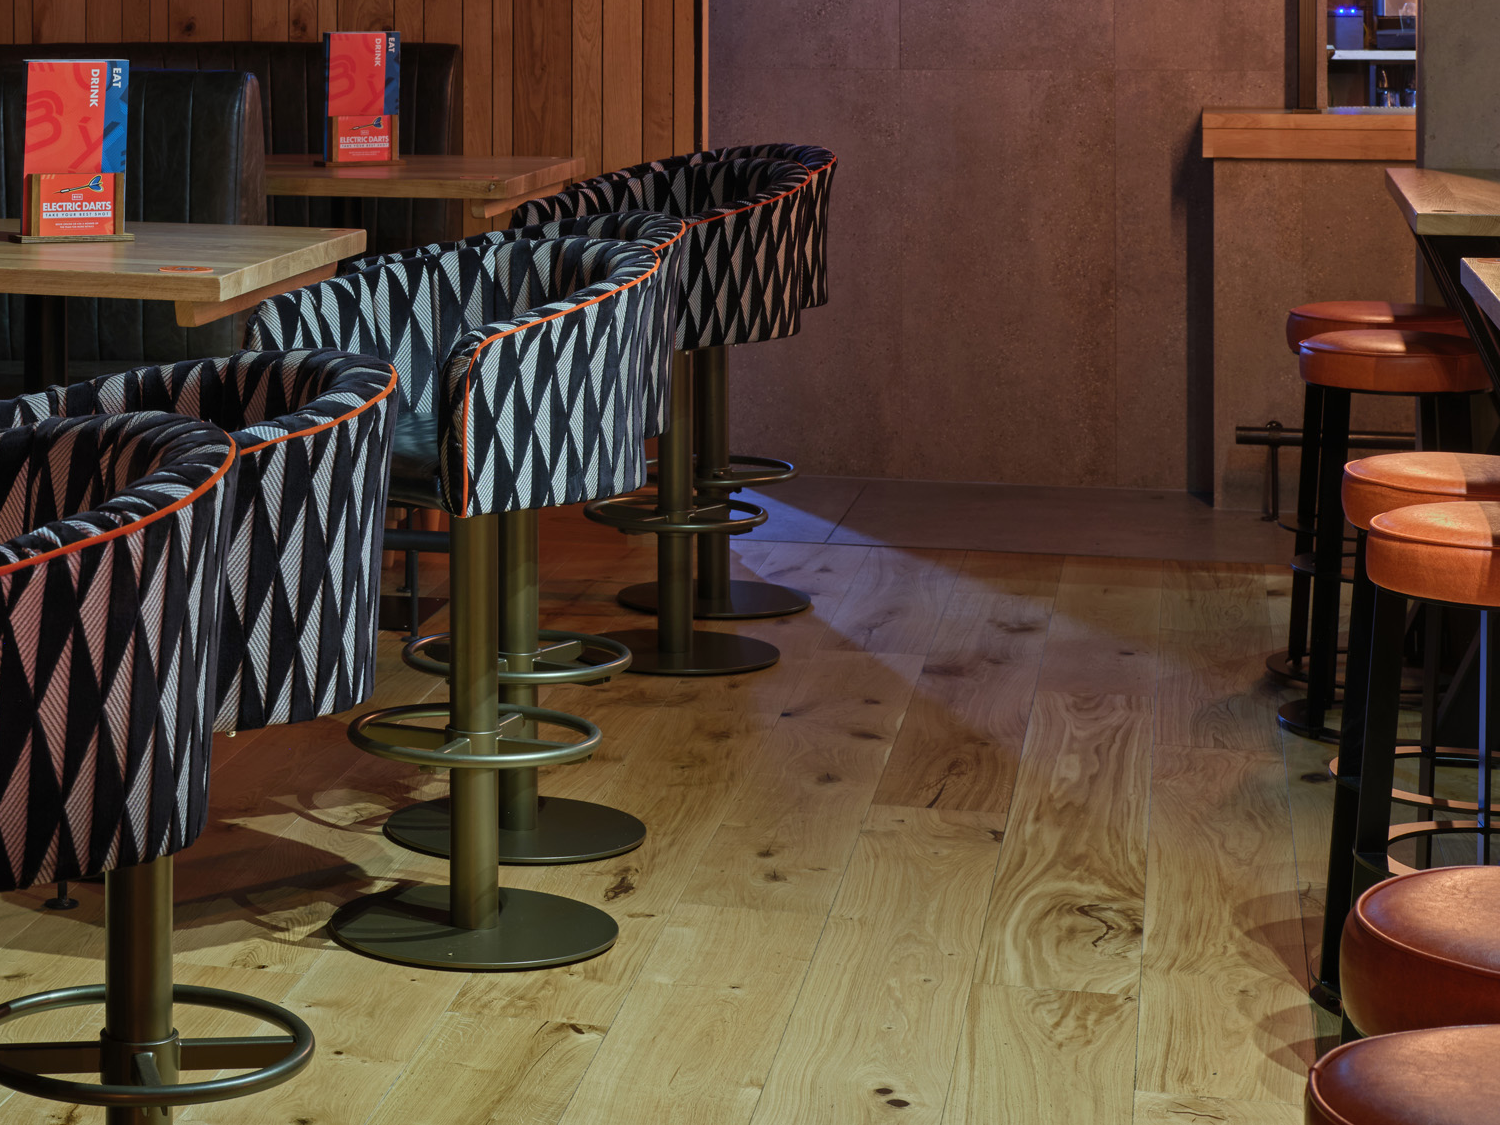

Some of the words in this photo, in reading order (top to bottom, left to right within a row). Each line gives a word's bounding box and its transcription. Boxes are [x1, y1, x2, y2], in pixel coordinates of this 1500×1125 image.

[374, 38, 382, 67] DRINK
[388, 37, 396, 53] EAT
[112, 68, 122, 89] EAT
[89, 69, 100, 108] DRINK
[369, 135, 389, 143] DARTS
[43, 202, 81, 211] ELECTRIC
[83, 201, 111, 210] DARTS
